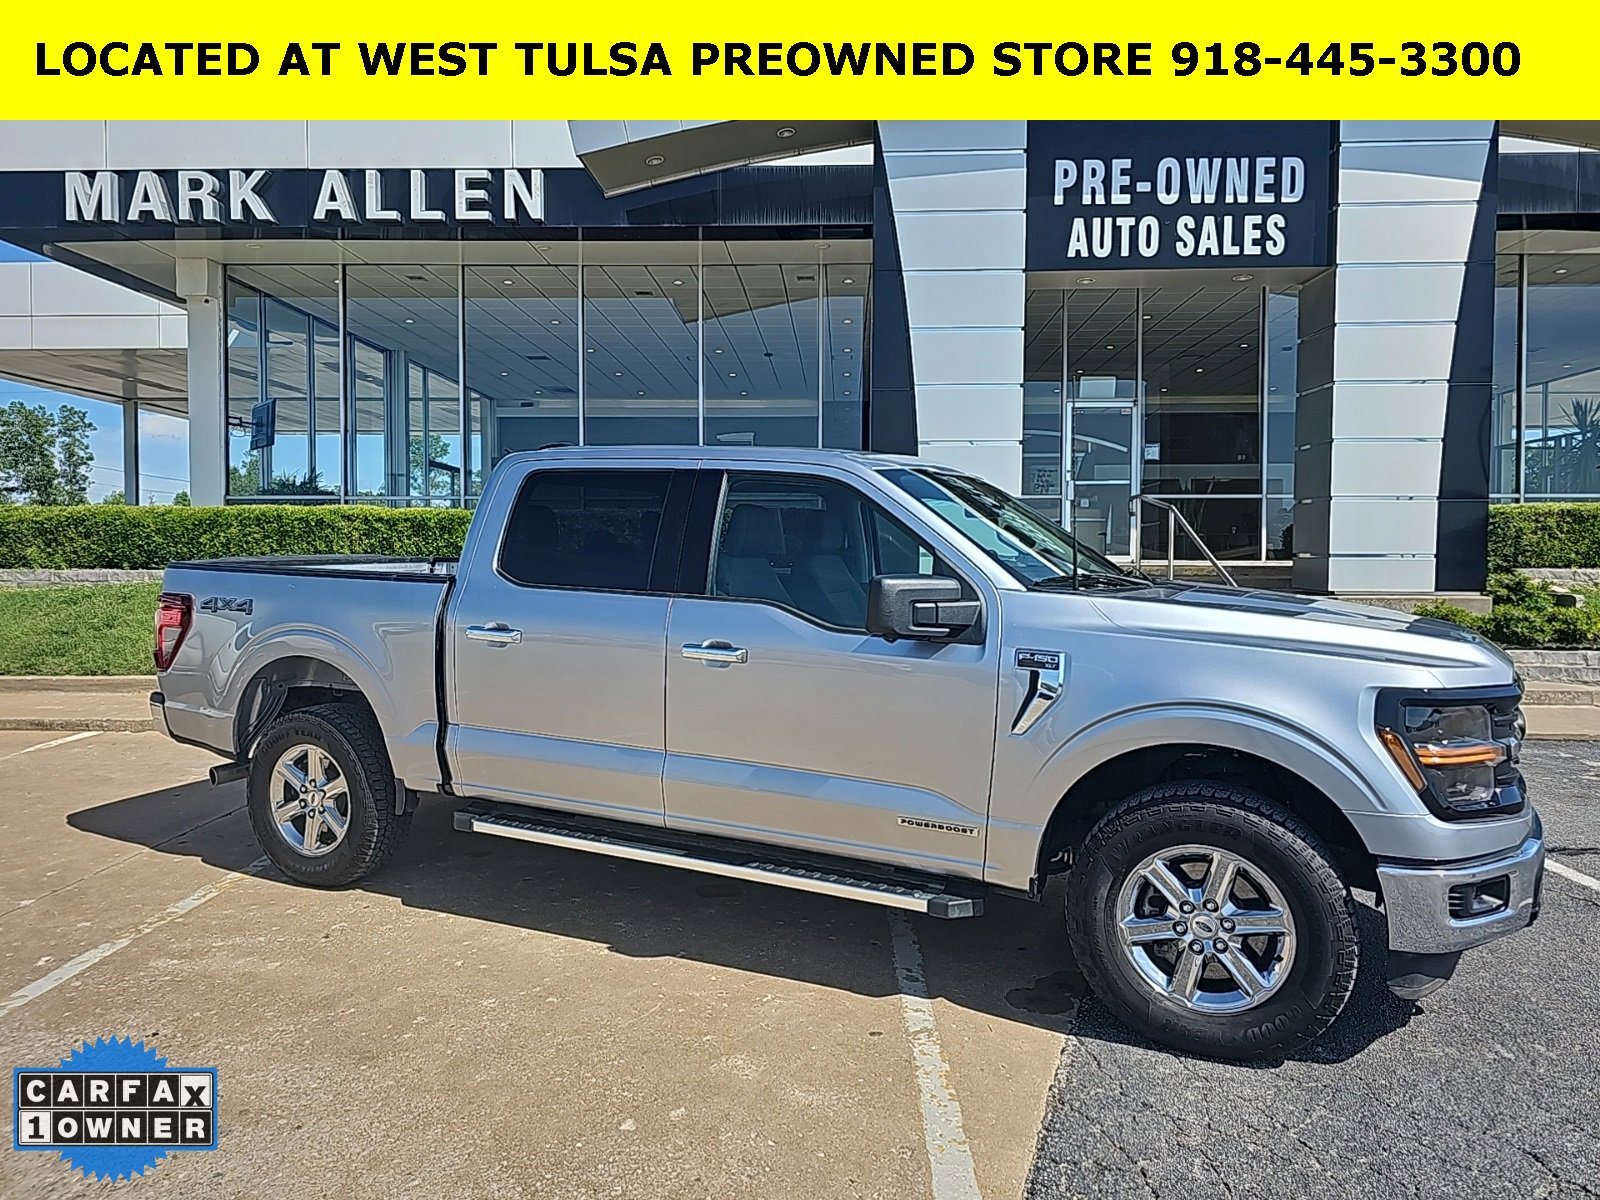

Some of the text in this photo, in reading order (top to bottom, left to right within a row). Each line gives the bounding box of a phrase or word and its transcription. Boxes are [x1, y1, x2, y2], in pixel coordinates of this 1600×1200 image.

[65, 168, 545, 223] MARK ALLEN
[1054, 157, 1305, 205] PRE-OWNED
[1067, 214, 1286, 258] AUTO SALES
[1019, 653, 1059, 663] F-150
[900, 818, 975, 836] POWERBOOST
